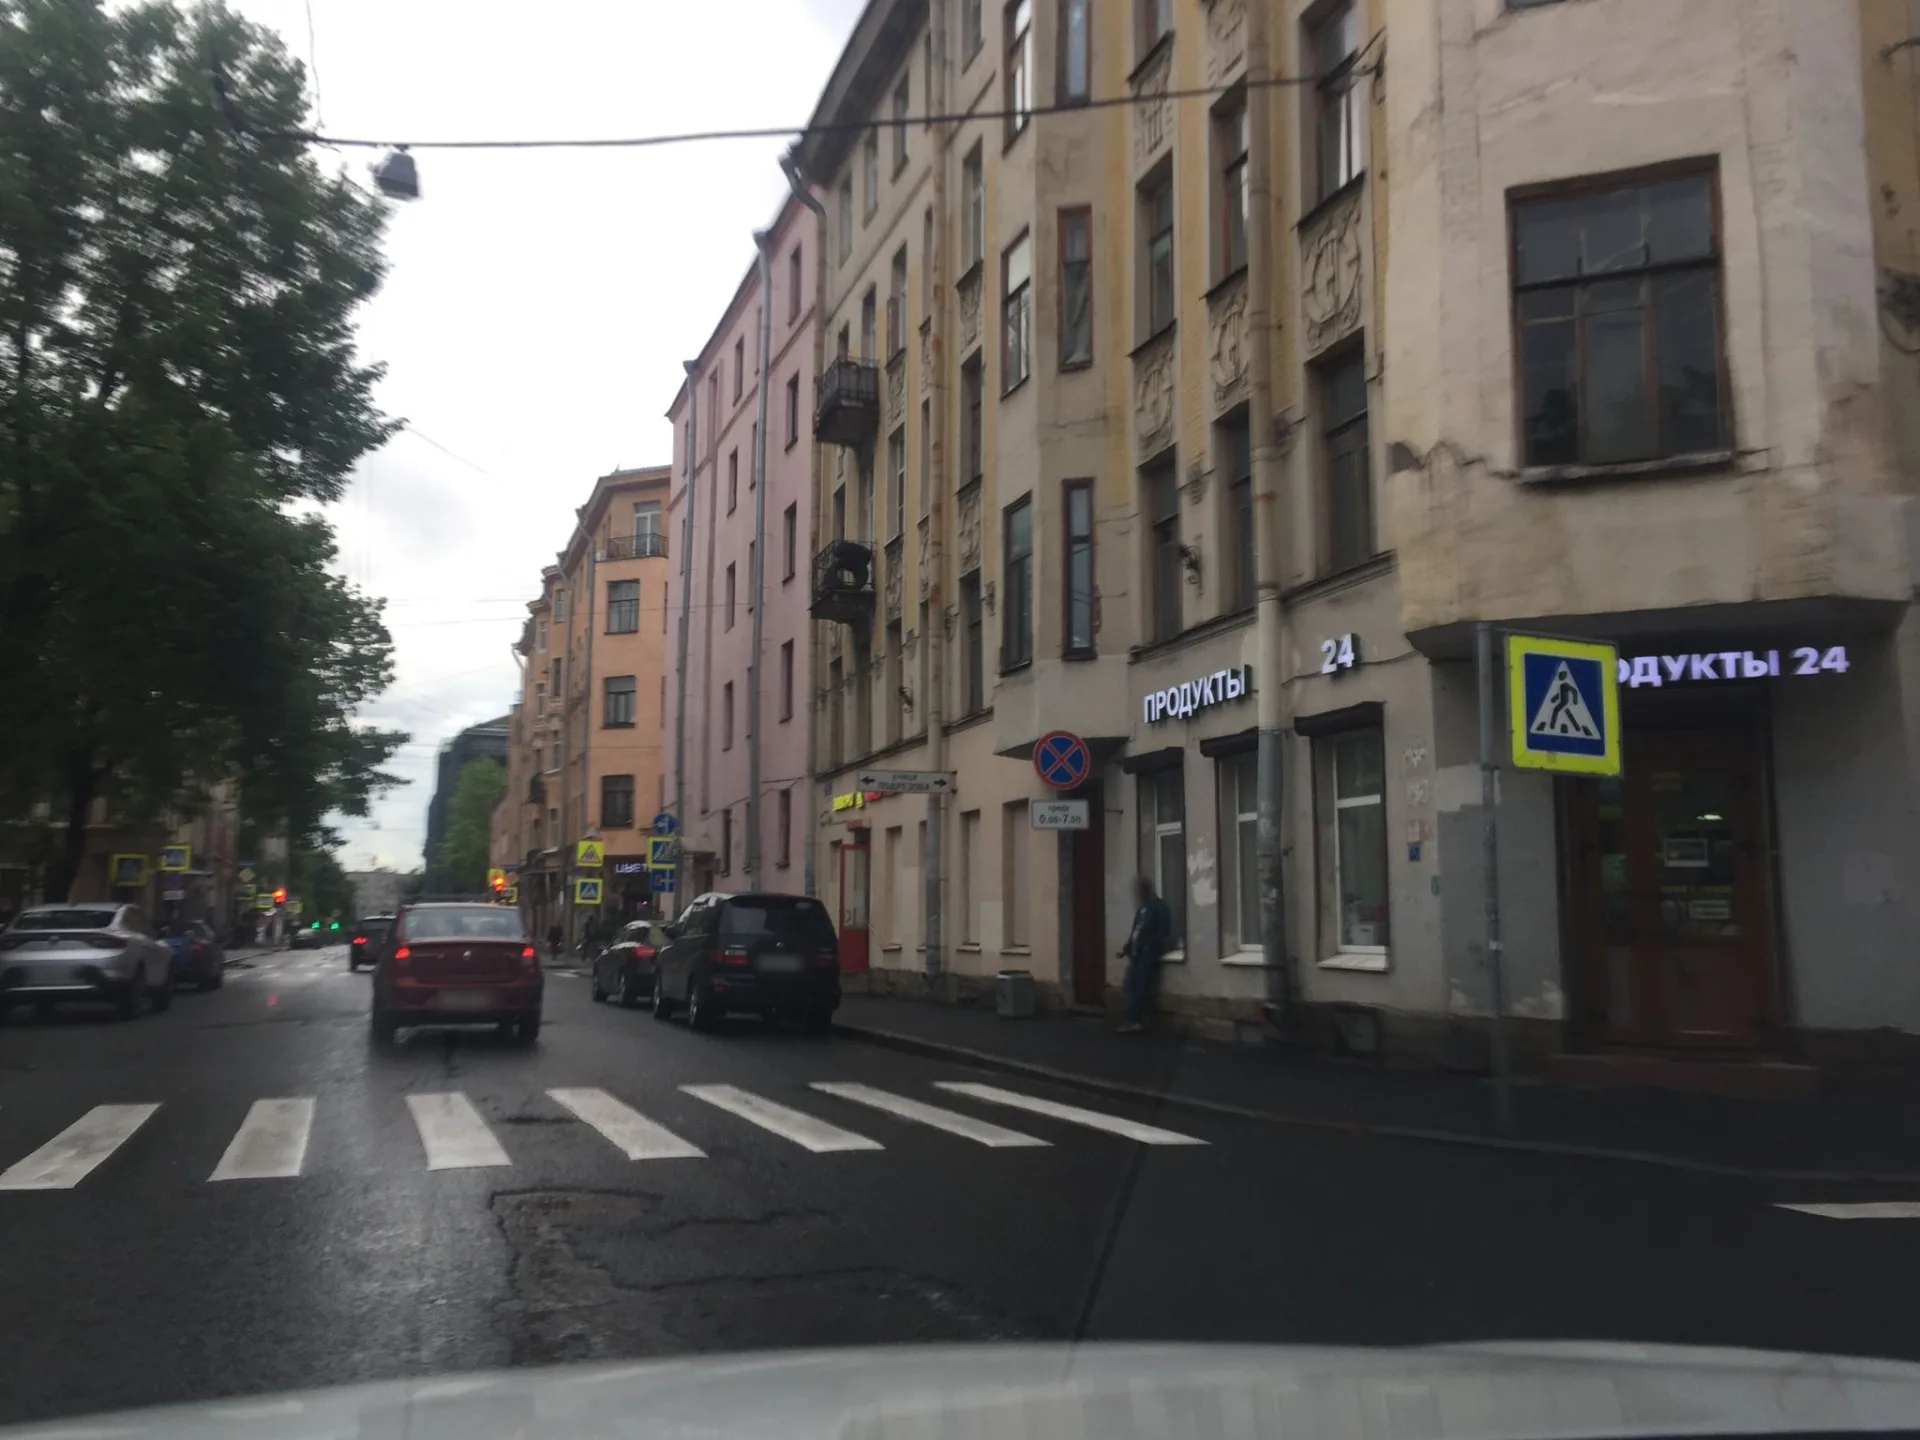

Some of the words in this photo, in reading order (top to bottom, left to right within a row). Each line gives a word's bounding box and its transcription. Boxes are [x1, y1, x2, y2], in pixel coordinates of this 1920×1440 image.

[1143, 664, 1250, 723] ПРОДУКТЫ
[1320, 633, 1354, 674] 24
[1793, 646, 1850, 675] 24
